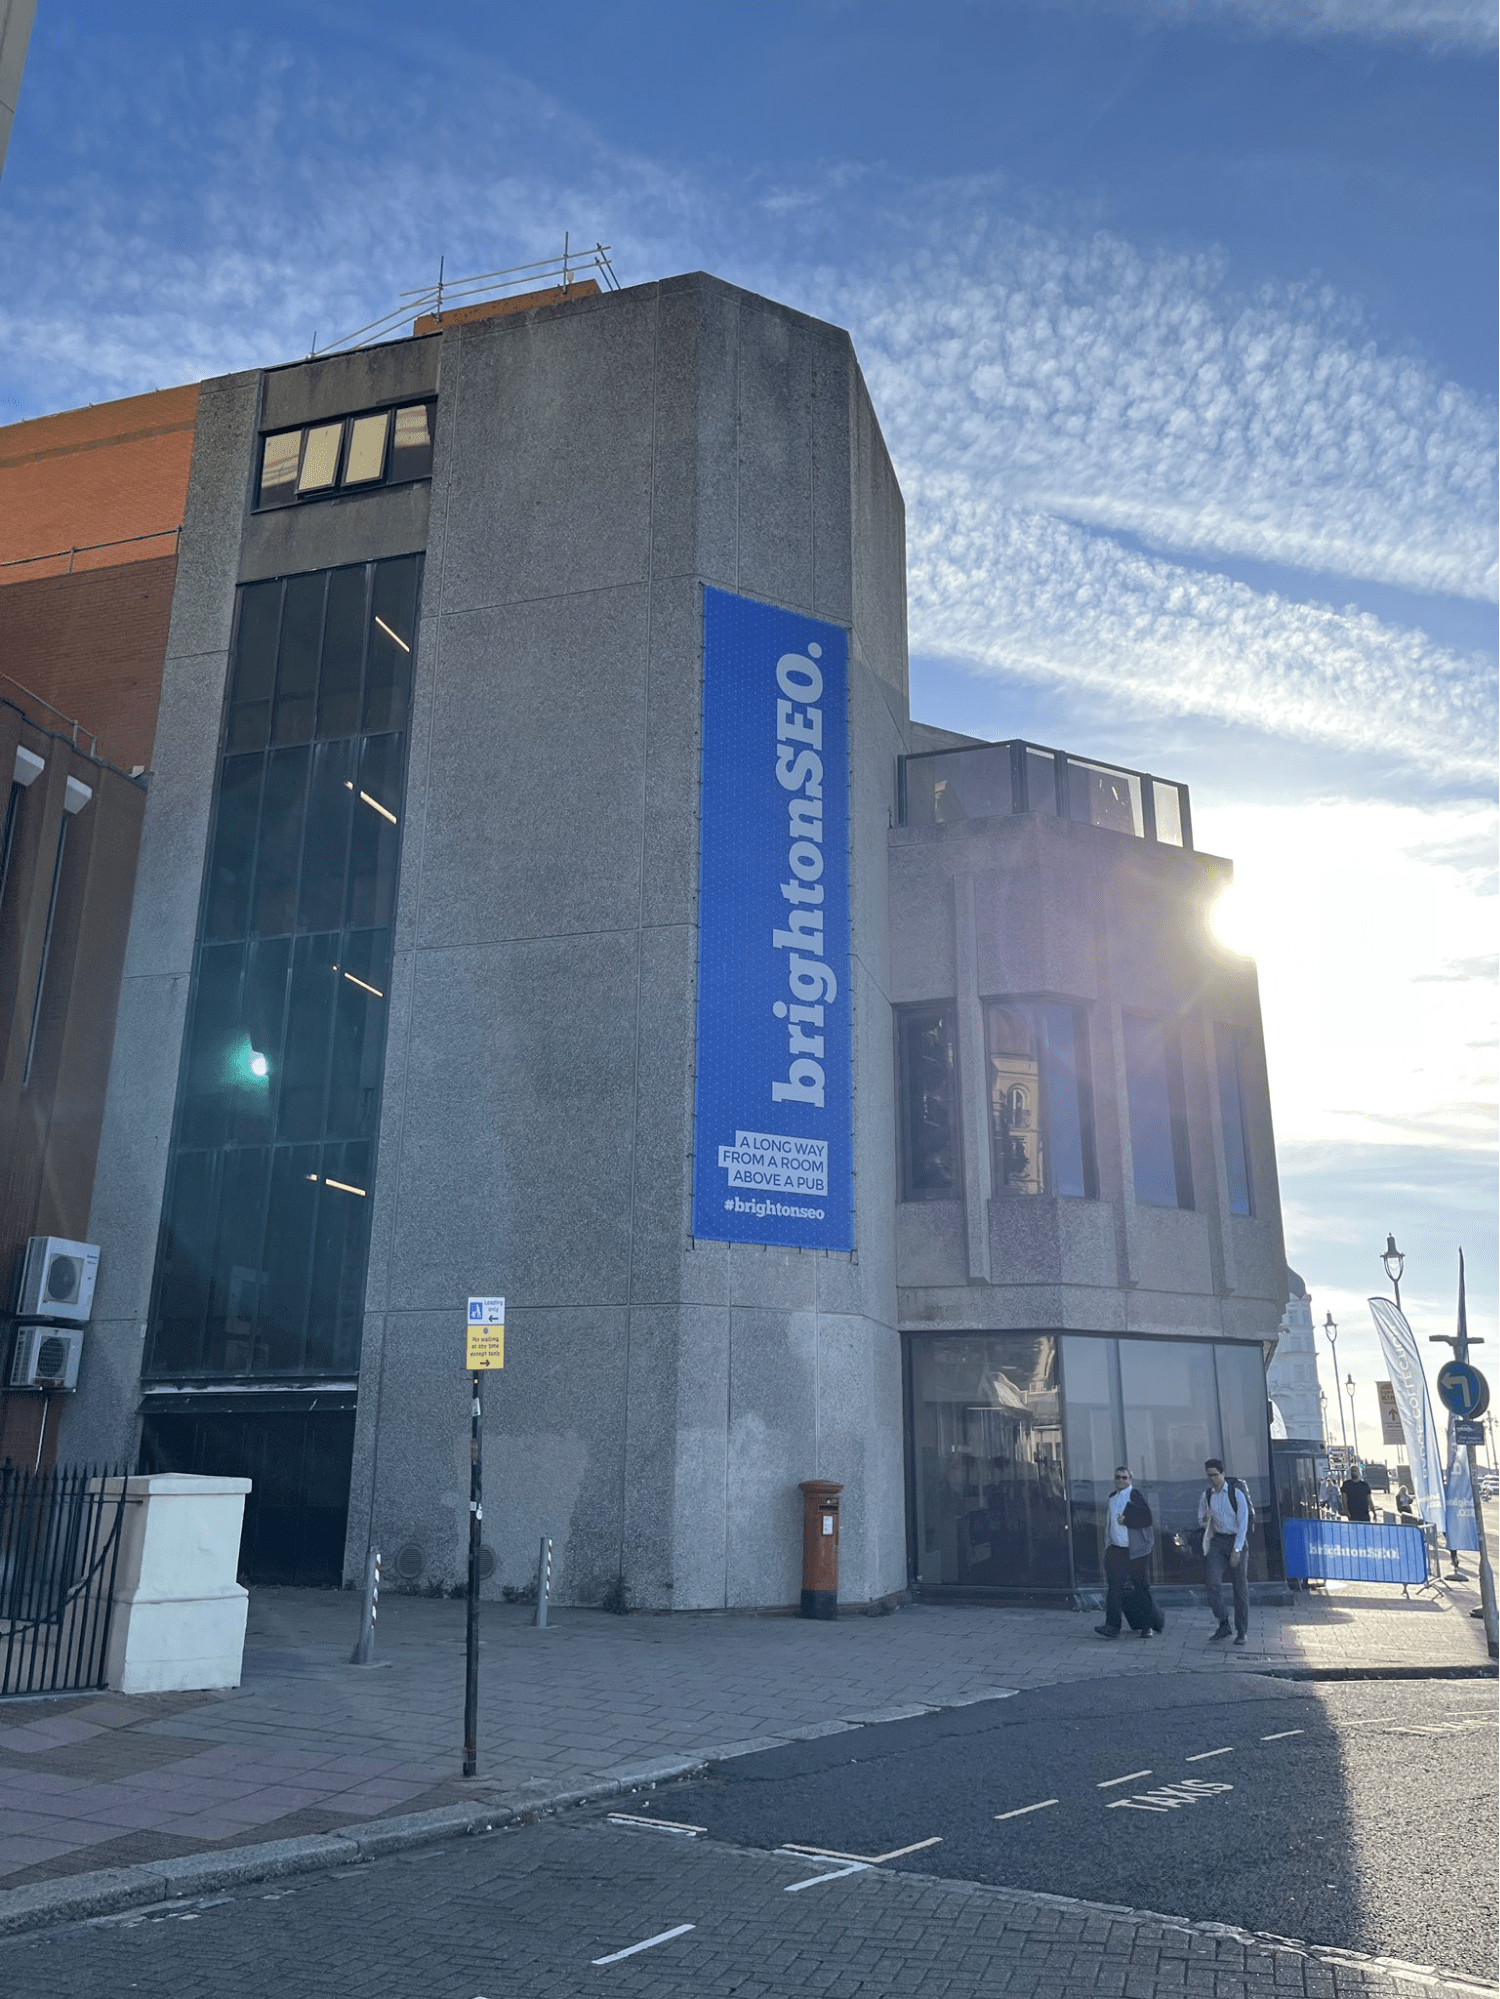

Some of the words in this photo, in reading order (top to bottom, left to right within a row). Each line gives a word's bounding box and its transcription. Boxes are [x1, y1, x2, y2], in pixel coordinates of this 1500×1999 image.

[772, 642, 838, 1108] brightonSEO.
[740, 1136, 750, 1148] A
[753, 1137, 792, 1153] LONG
[795, 1143, 825, 1157] WAY
[723, 1150, 764, 1166] FROM
[768, 1155, 778, 1168] A
[781, 1157, 824, 1173] ROOM
[733, 1170, 781, 1186] ABOVE
[784, 1175, 794, 1188] A
[797, 1176, 824, 1191] PUB
[724, 1197, 825, 1220] #brightonseo
[1105, 1779, 1234, 1812] TAXIS
